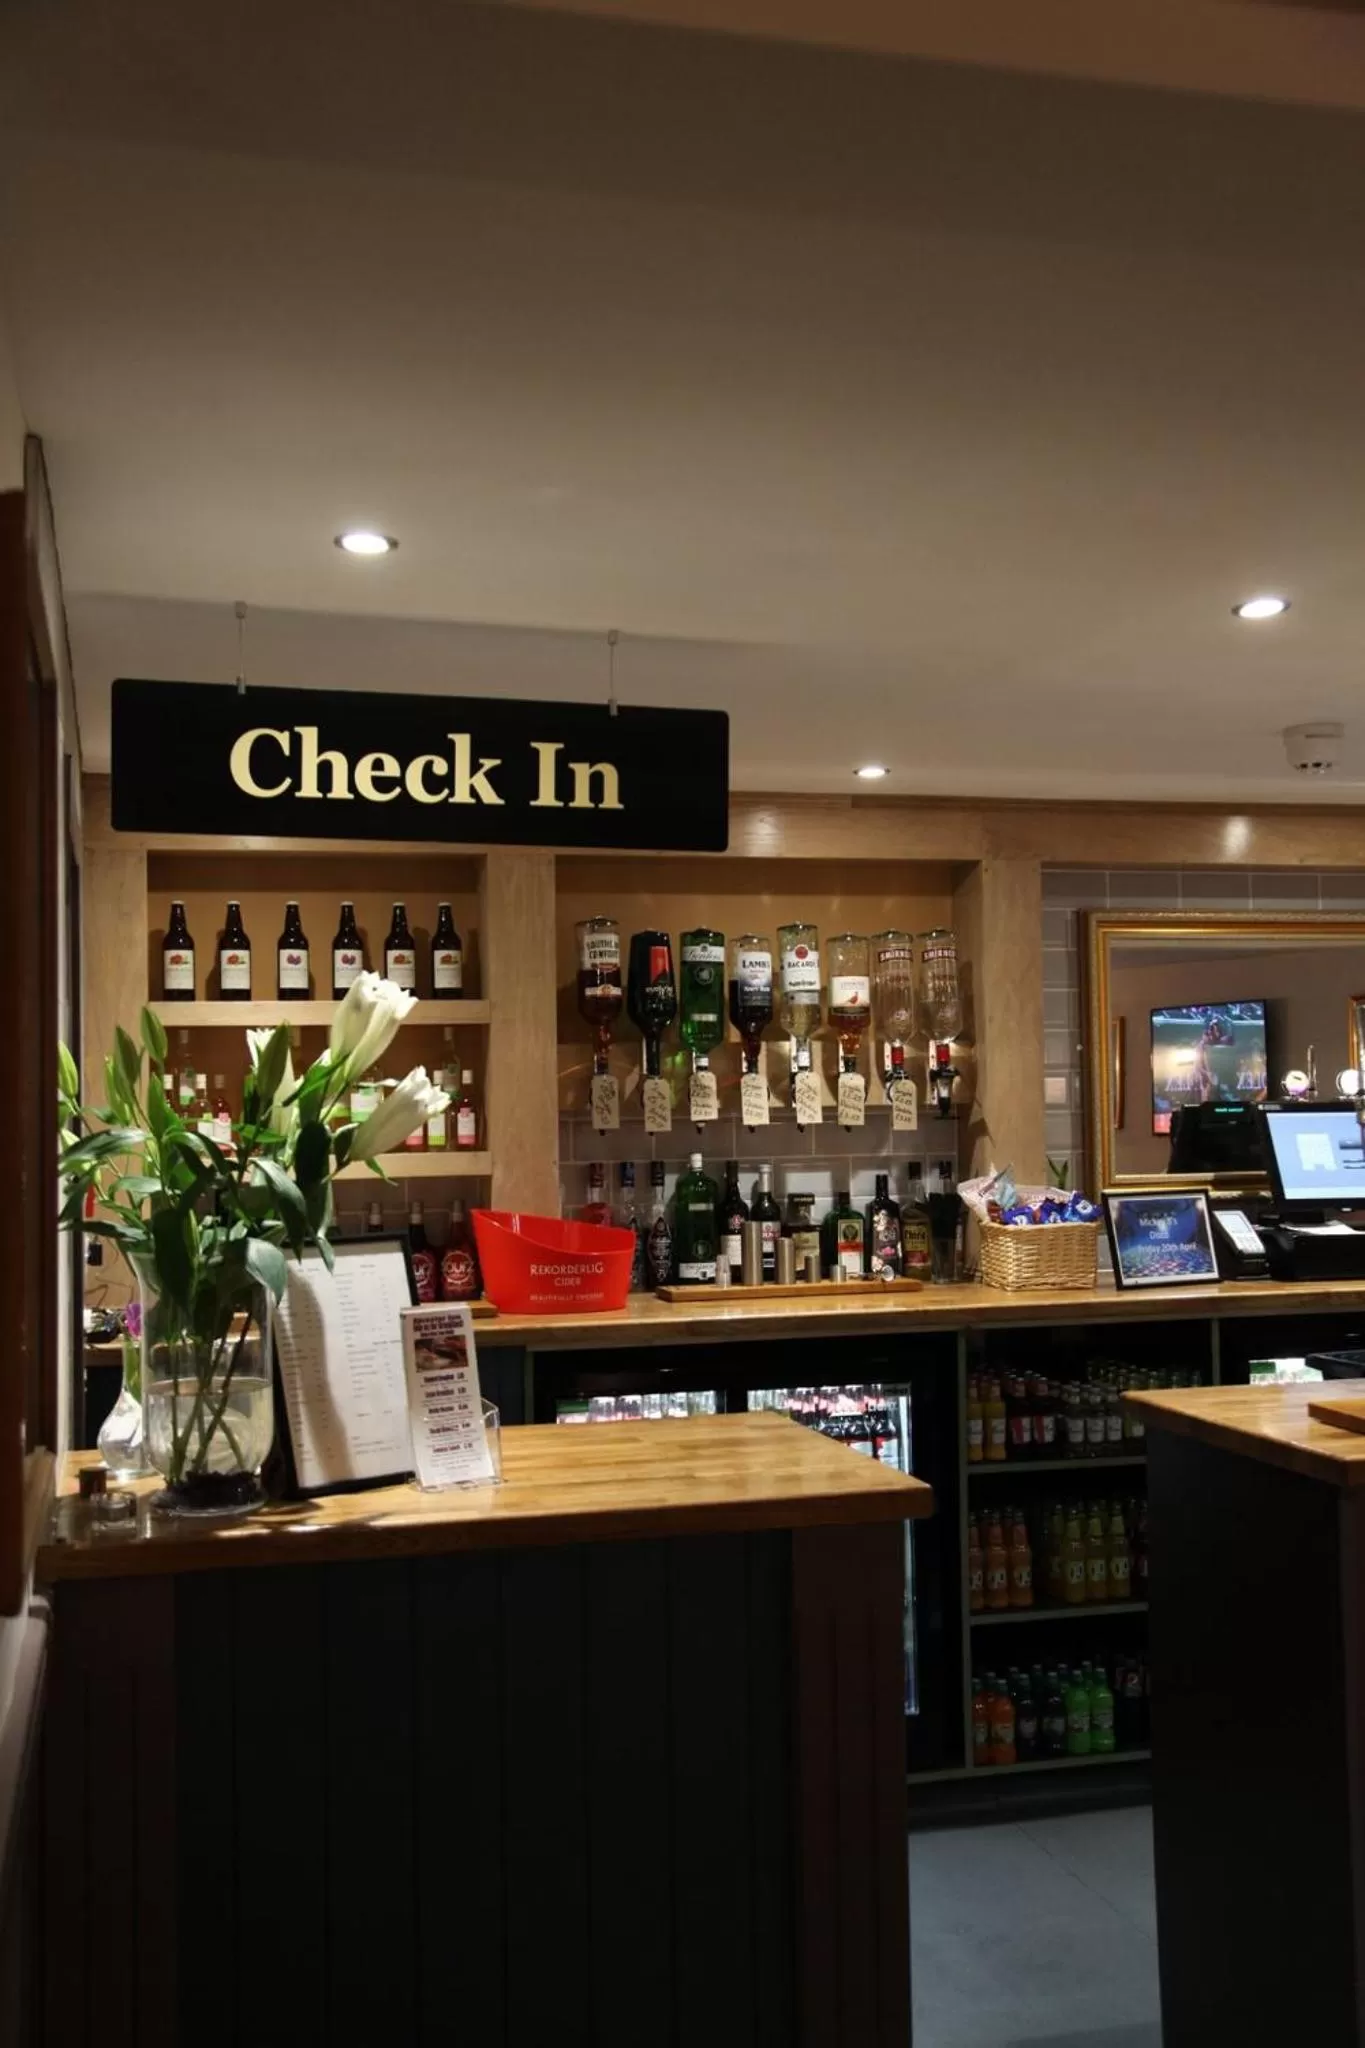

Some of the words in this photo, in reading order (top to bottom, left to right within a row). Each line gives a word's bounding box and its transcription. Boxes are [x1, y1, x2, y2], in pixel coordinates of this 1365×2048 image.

[229, 726, 505, 806] Check
[530, 742, 623, 809] In
[530, 1261, 604, 1276] REKORDERLIG
